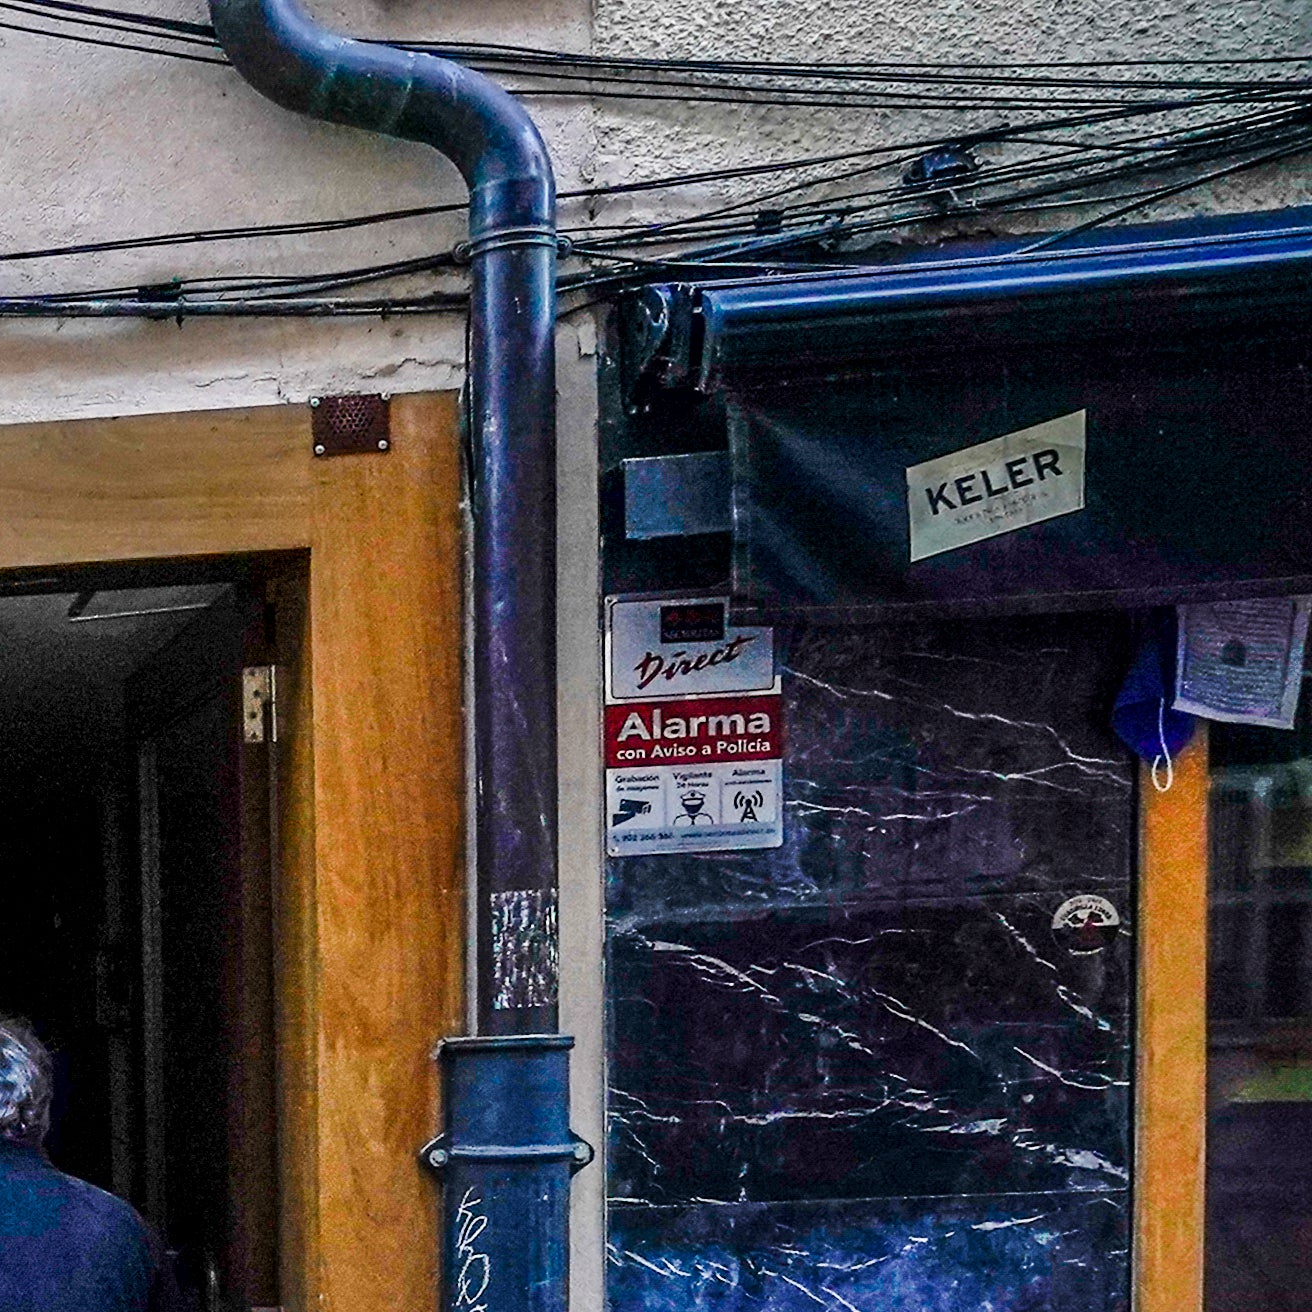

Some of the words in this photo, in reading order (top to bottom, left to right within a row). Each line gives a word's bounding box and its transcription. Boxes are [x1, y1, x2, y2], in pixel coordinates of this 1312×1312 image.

[925, 448, 1064, 515] KELER
[634, 635, 757, 689] Direct
[617, 709, 771, 742] Alarma
[616, 749, 646, 760] con
[650, 744, 697, 758] Aviso
[701, 745, 712, 755] a
[717, 739, 771, 754] Policía
[673, 771, 712, 781] Vigilante
[732, 769, 766, 777] Alarma
